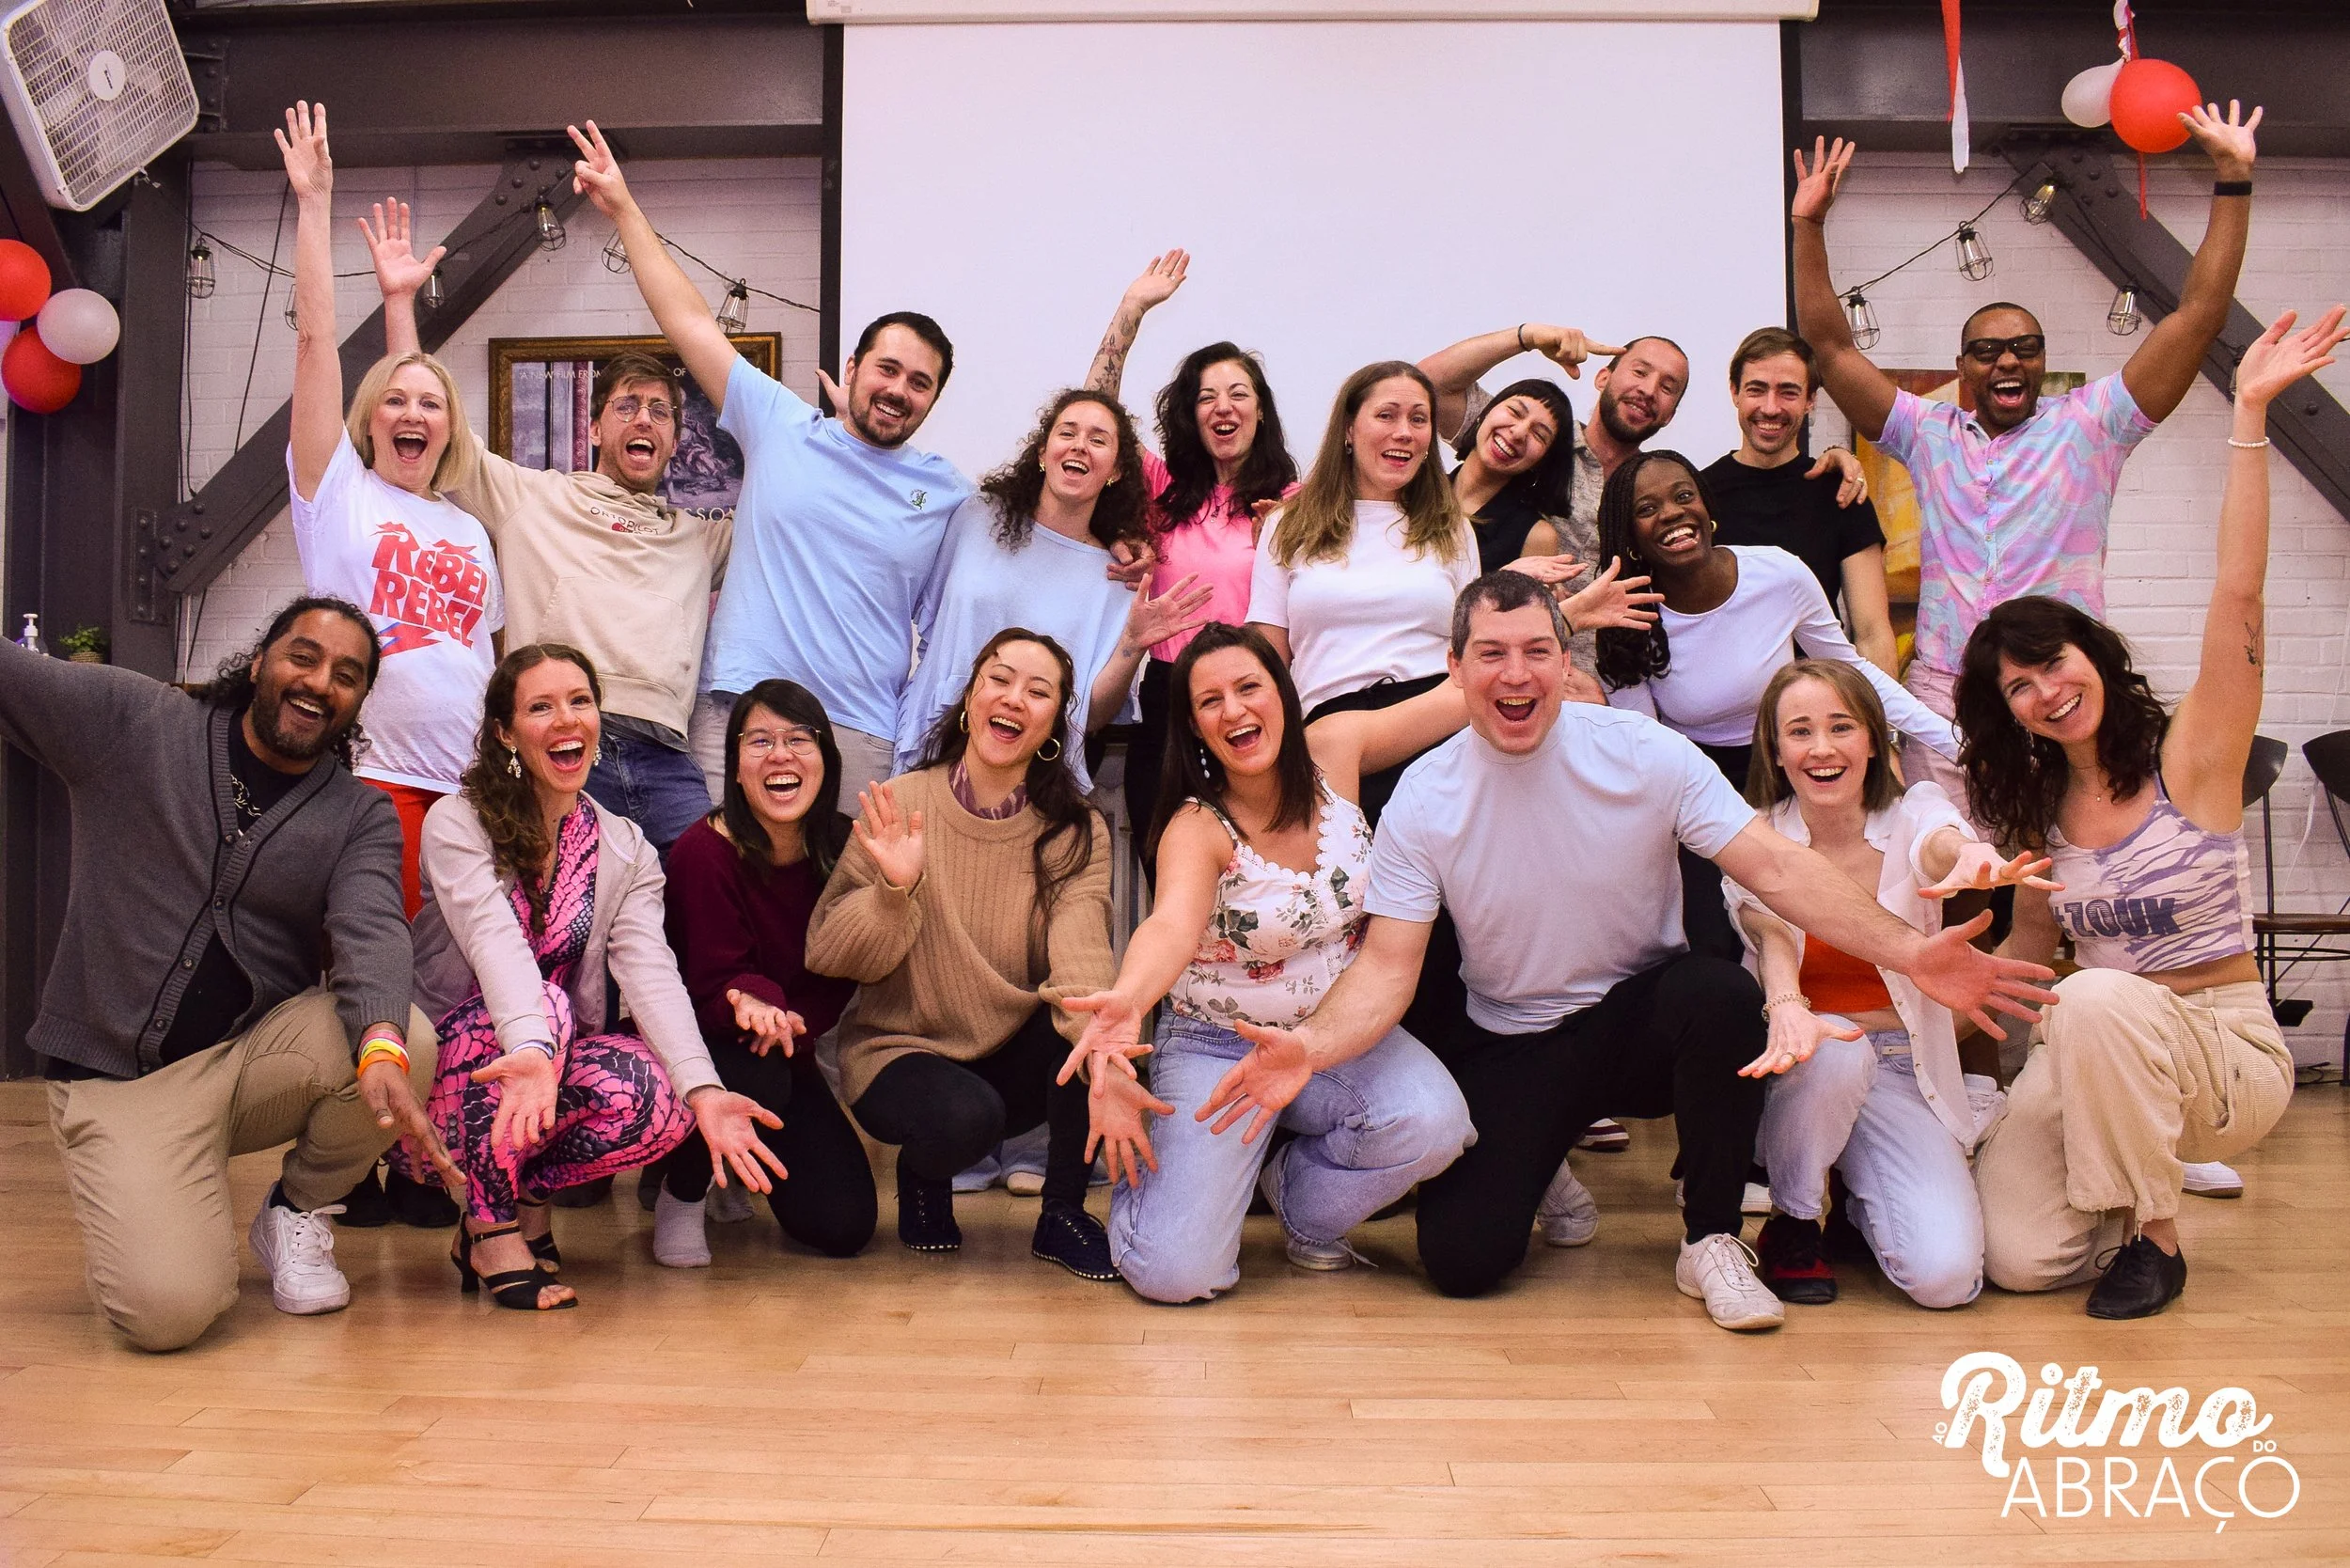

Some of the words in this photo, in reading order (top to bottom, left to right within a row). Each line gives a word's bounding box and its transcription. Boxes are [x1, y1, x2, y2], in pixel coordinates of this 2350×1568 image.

[556, 370, 575, 379] FILM
[673, 368, 686, 376] OF
[369, 522, 488, 606] REBEL
[369, 570, 484, 650] REBEL
